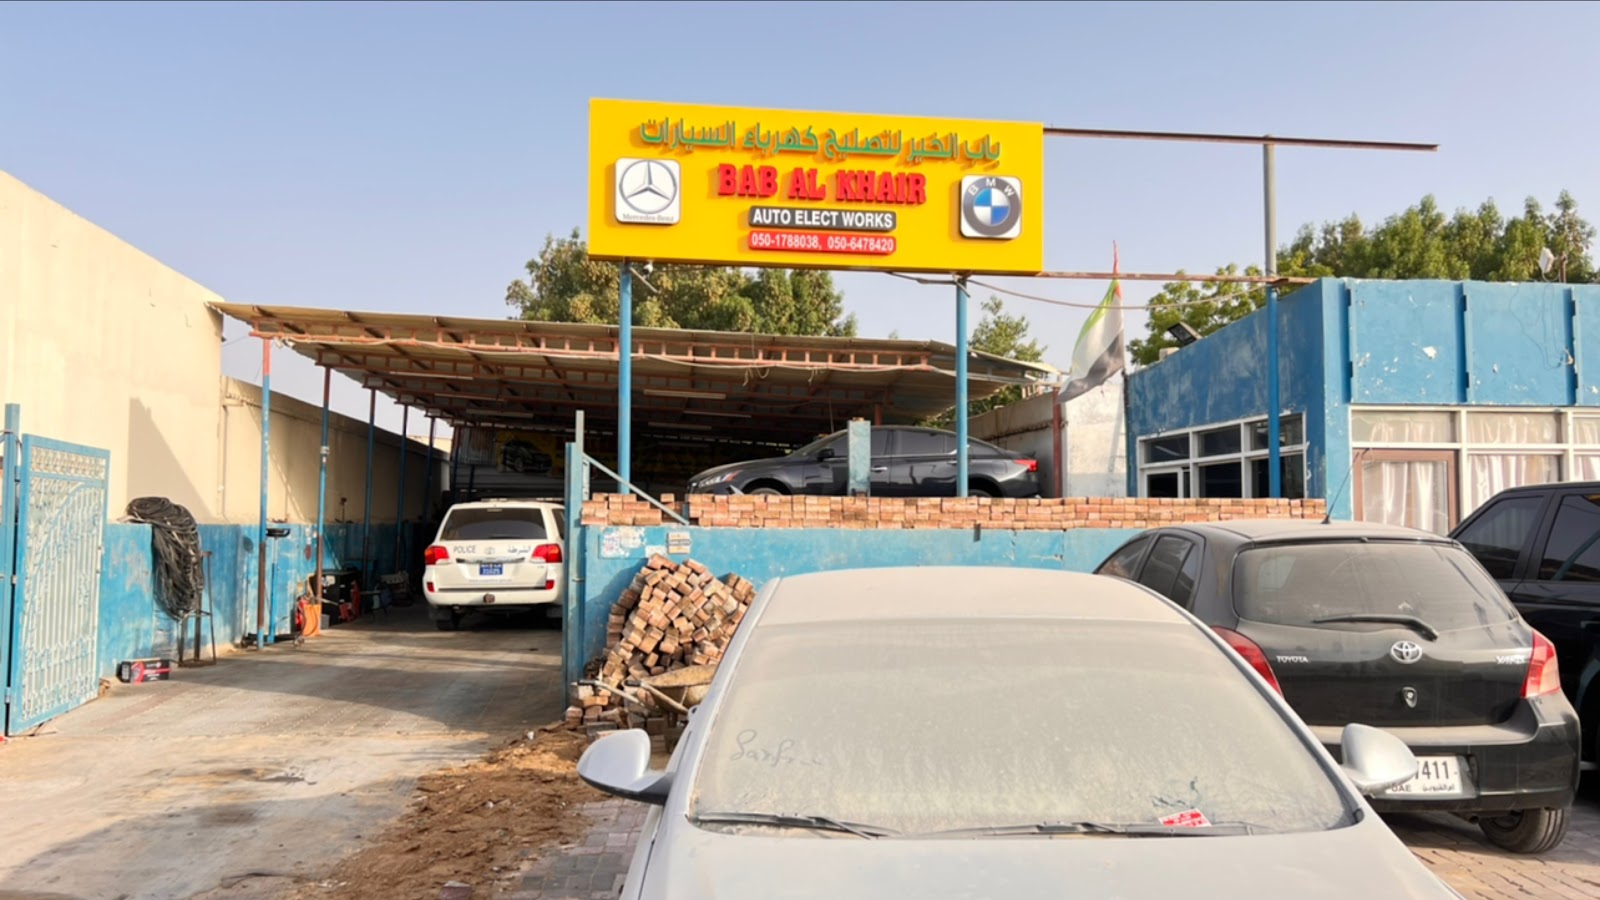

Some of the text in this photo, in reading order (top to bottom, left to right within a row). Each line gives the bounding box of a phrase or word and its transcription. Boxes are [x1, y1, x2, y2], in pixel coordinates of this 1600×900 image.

[640, 117, 736, 151] السيارات
[743, 122, 819, 155] كهرباء
[825, 127, 902, 160] لتصليح
[908, 132, 958, 163] الخير
[718, 163, 927, 205] BAB AL KHAIR
[967, 177, 1016, 197] BMW
[752, 208, 893, 229] AUTO ELECT WORKS
[751, 232, 894, 252] 050-1788038, 050-6478420
[453, 545, 477, 554] POLICE
[1276, 655, 1309, 664] TOYOTA
